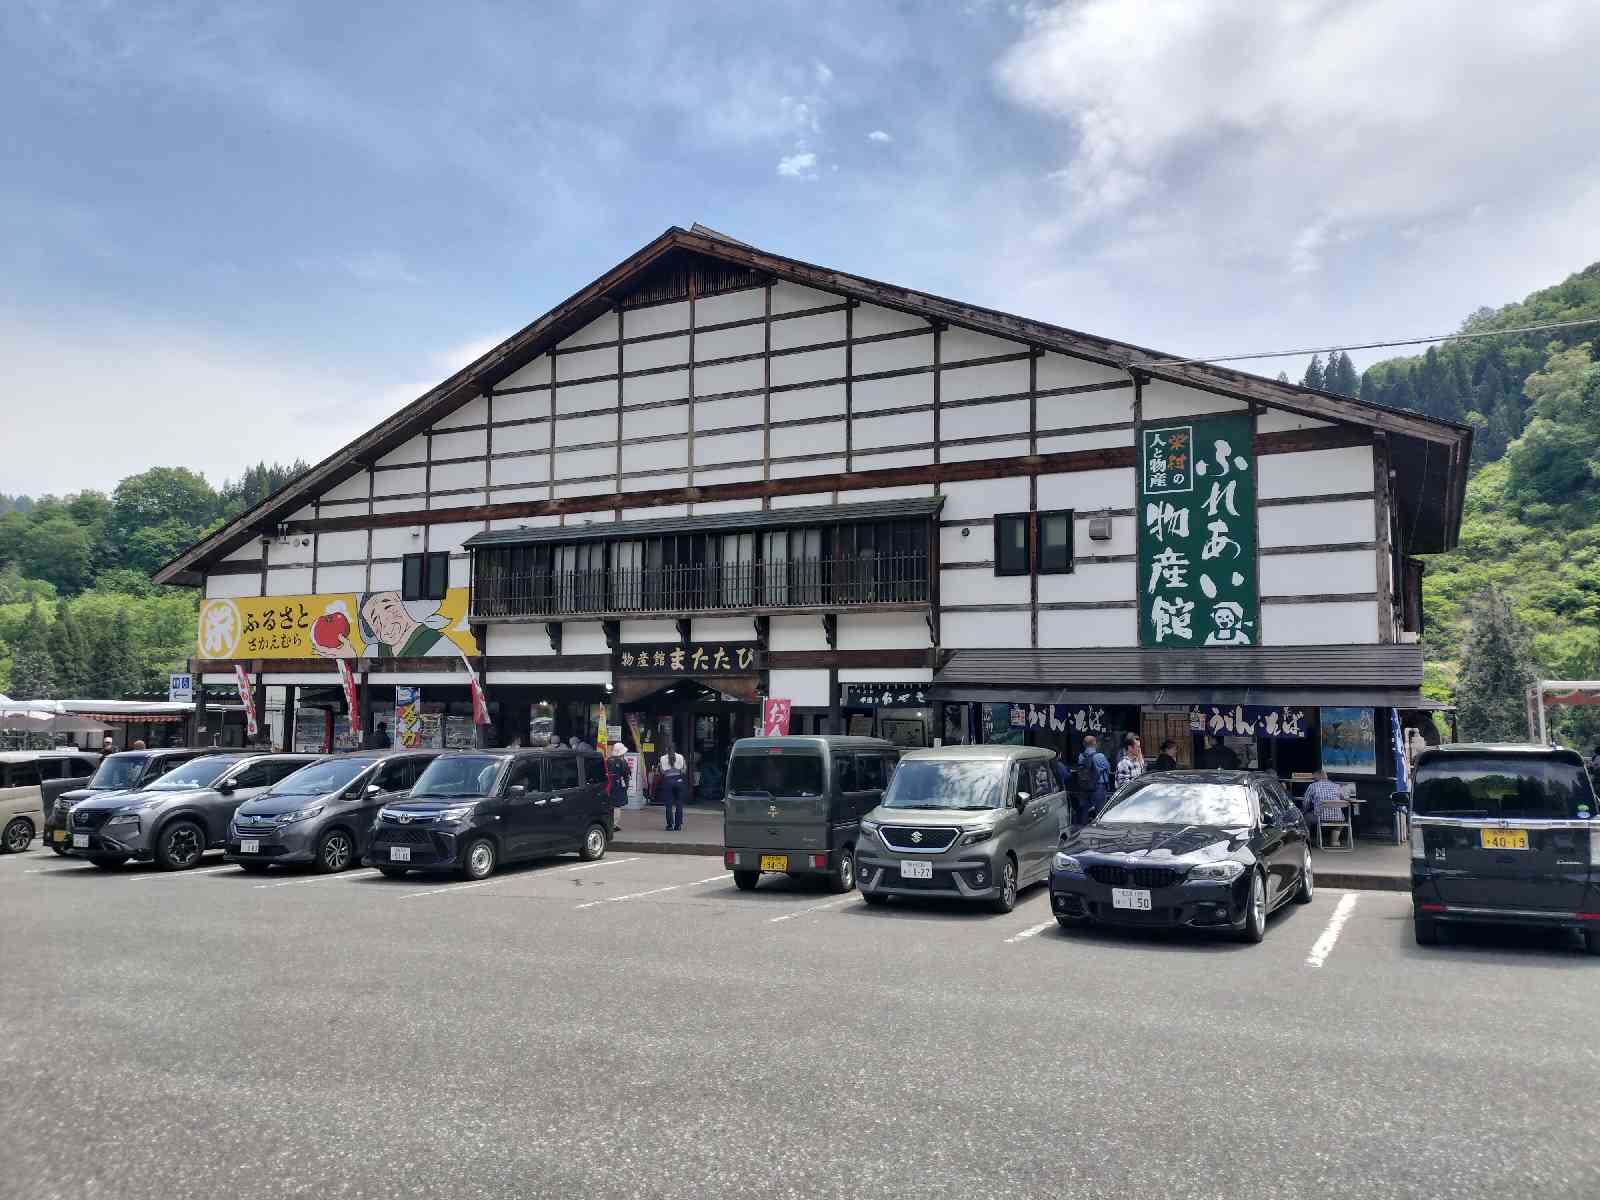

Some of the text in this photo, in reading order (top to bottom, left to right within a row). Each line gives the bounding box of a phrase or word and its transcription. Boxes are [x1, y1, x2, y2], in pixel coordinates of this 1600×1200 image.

[1149, 433, 1168, 487] 人と物産
[1195, 439, 1249, 599] ふれあい
[1146, 501, 1195, 643] 物産館
[243, 603, 309, 634] ふるさと
[247, 632, 303, 652] さかえむら
[621, 646, 754, 671] 物産館 またたび
